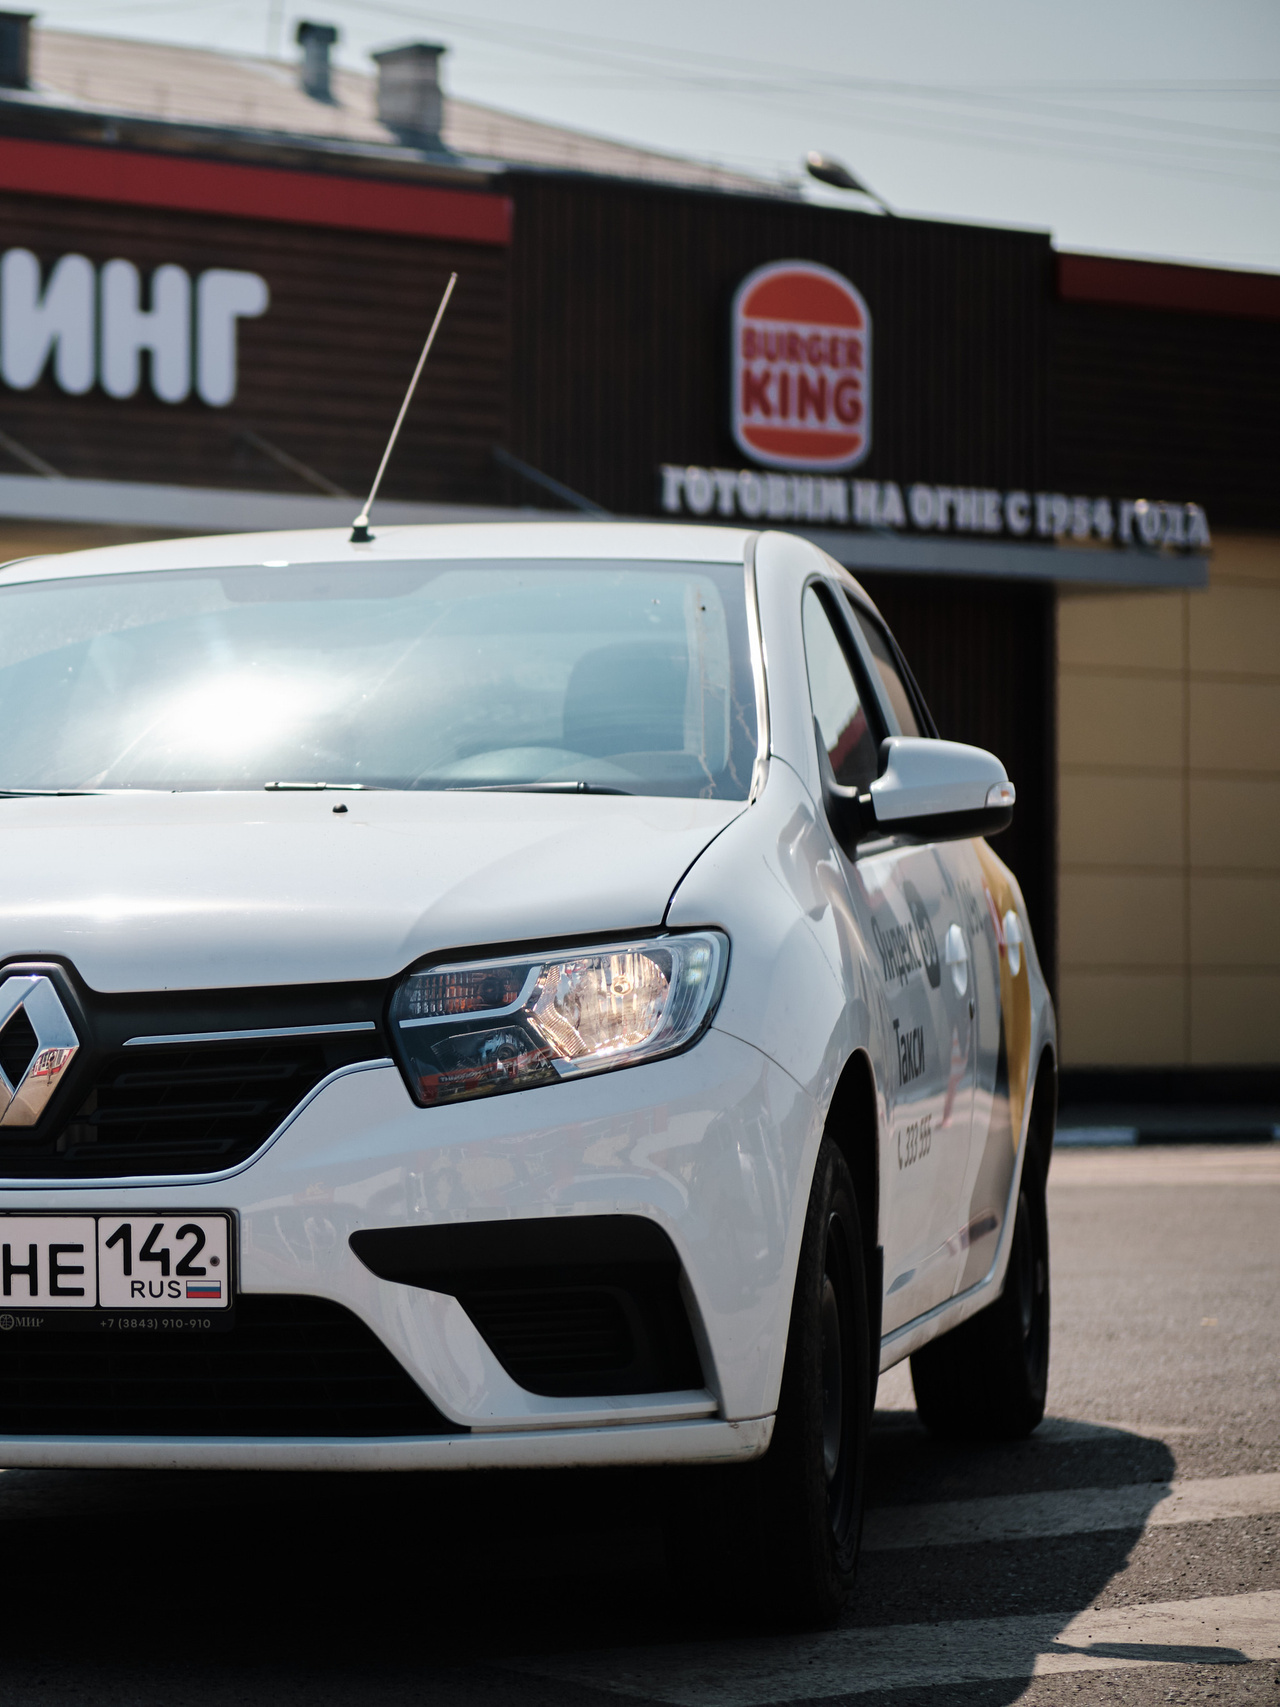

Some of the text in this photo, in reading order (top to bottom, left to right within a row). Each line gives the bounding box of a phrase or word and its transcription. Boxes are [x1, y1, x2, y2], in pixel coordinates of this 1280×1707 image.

[740, 328, 863, 371] BURGER
[740, 370, 863, 426] KING
[660, 464, 849, 521] ГОТОВИМ
[852, 478, 907, 527] НА
[909, 482, 1002, 533] ОГНЕ
[1034, 491, 1115, 541] 1954
[1117, 498, 1212, 547] ГОДА
[871, 915, 922, 988] Яндекс
[893, 1018, 925, 1087] Такси
[904, 1113, 932, 1168] 333 555
[105, 1223, 207, 1276] 142
[131, 1280, 182, 1298] RUS
[100, 1318, 211, 1330] +7 (3843) 910-910
